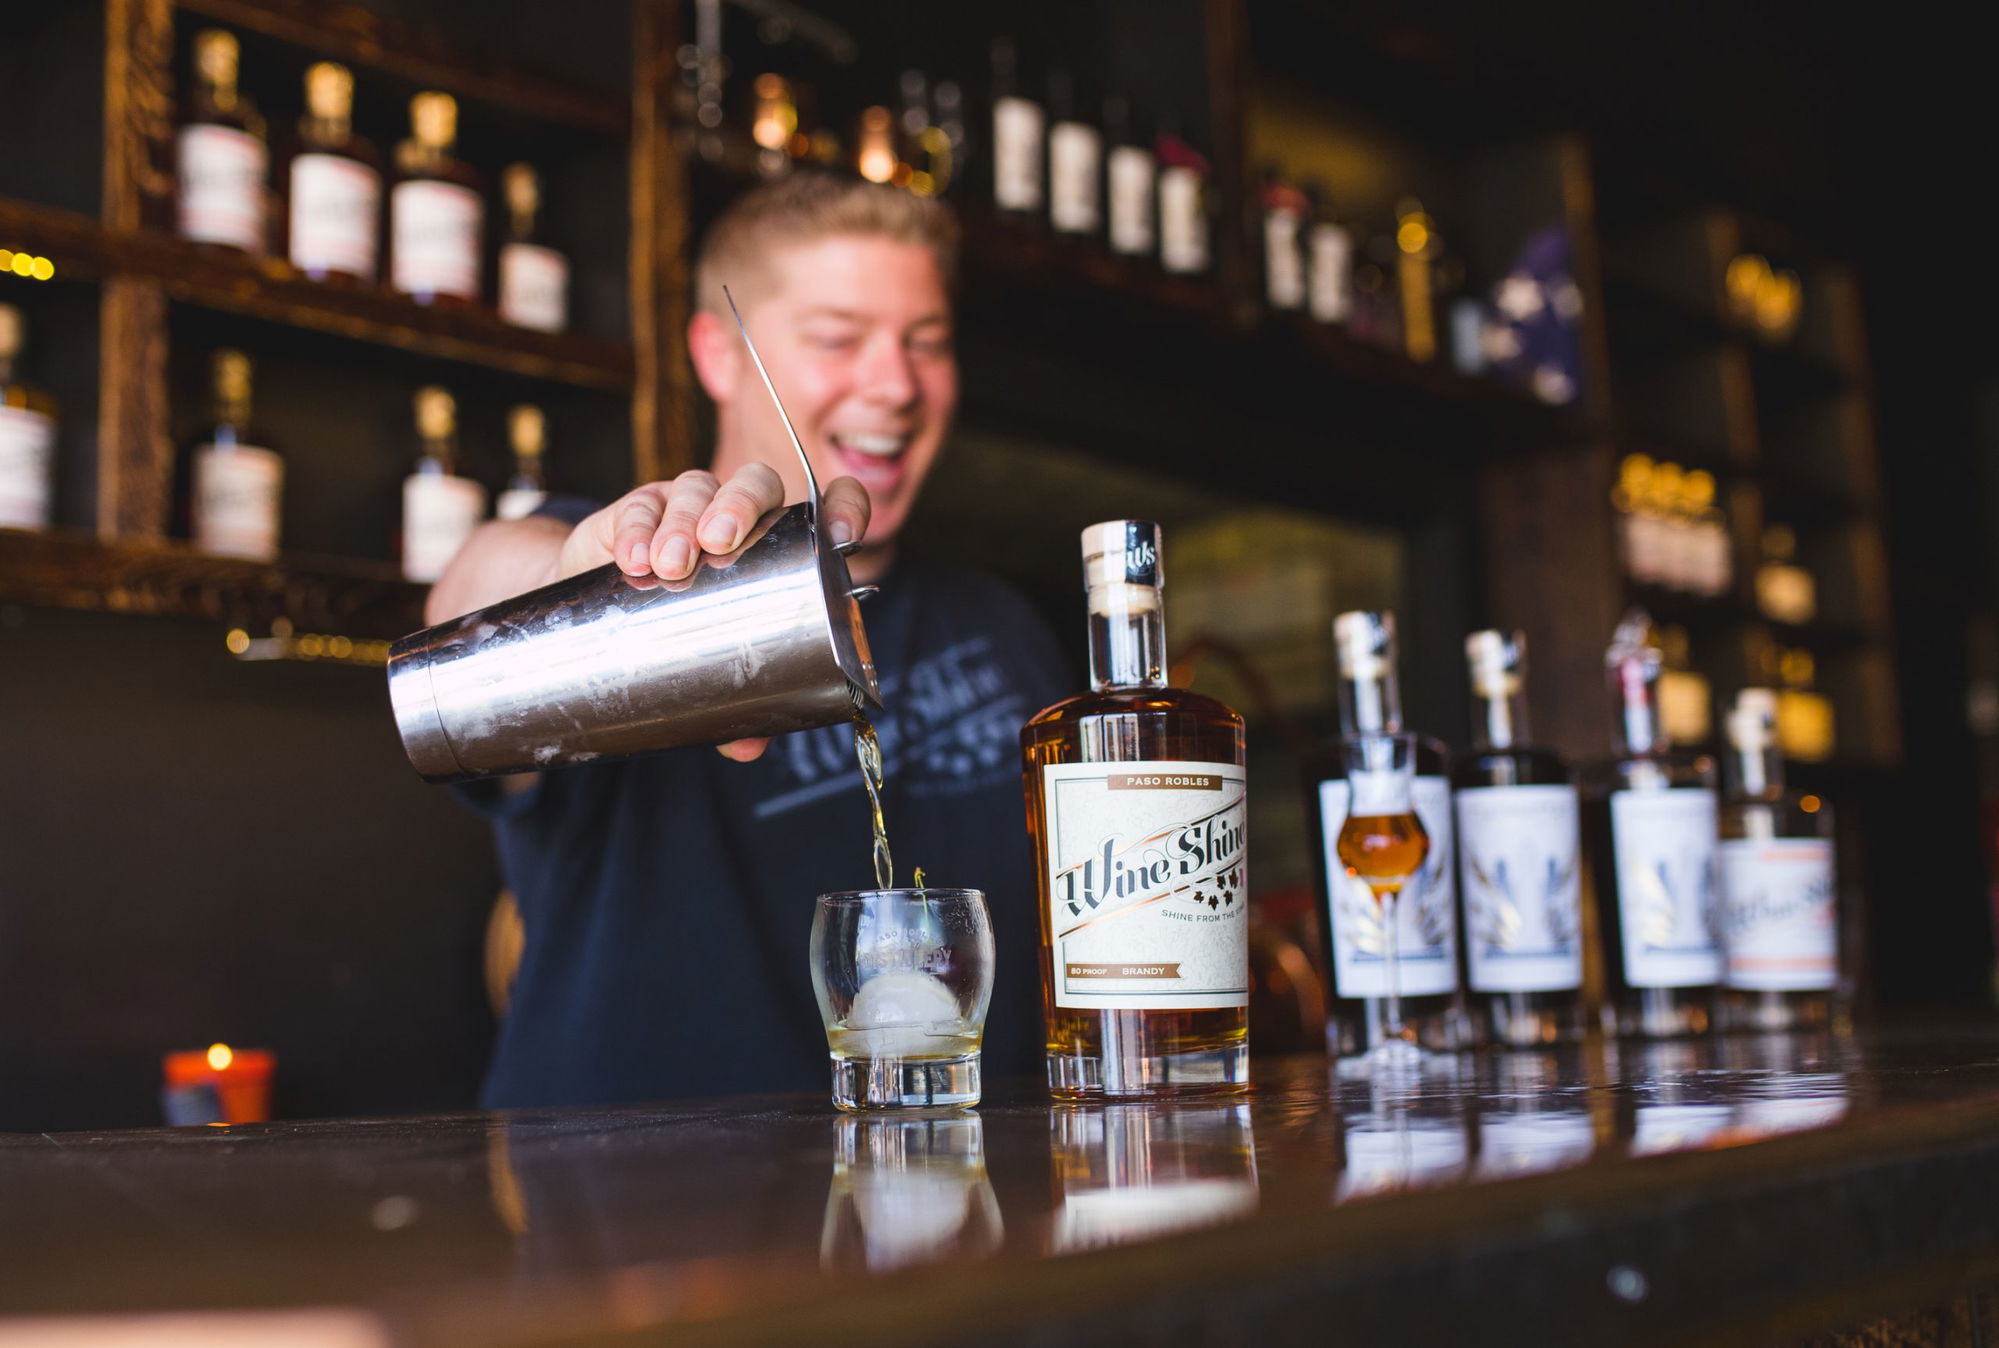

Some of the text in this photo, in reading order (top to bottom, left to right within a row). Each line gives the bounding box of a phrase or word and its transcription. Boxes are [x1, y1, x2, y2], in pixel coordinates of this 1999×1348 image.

[1127, 777, 1210, 786] PASO ROBLES
[1062, 816, 1245, 917] Wine Shine
[1161, 909, 1236, 923] SHINE FROM THE
[1070, 967, 1082, 975] 80
[1122, 967, 1165, 975] BRANDY
